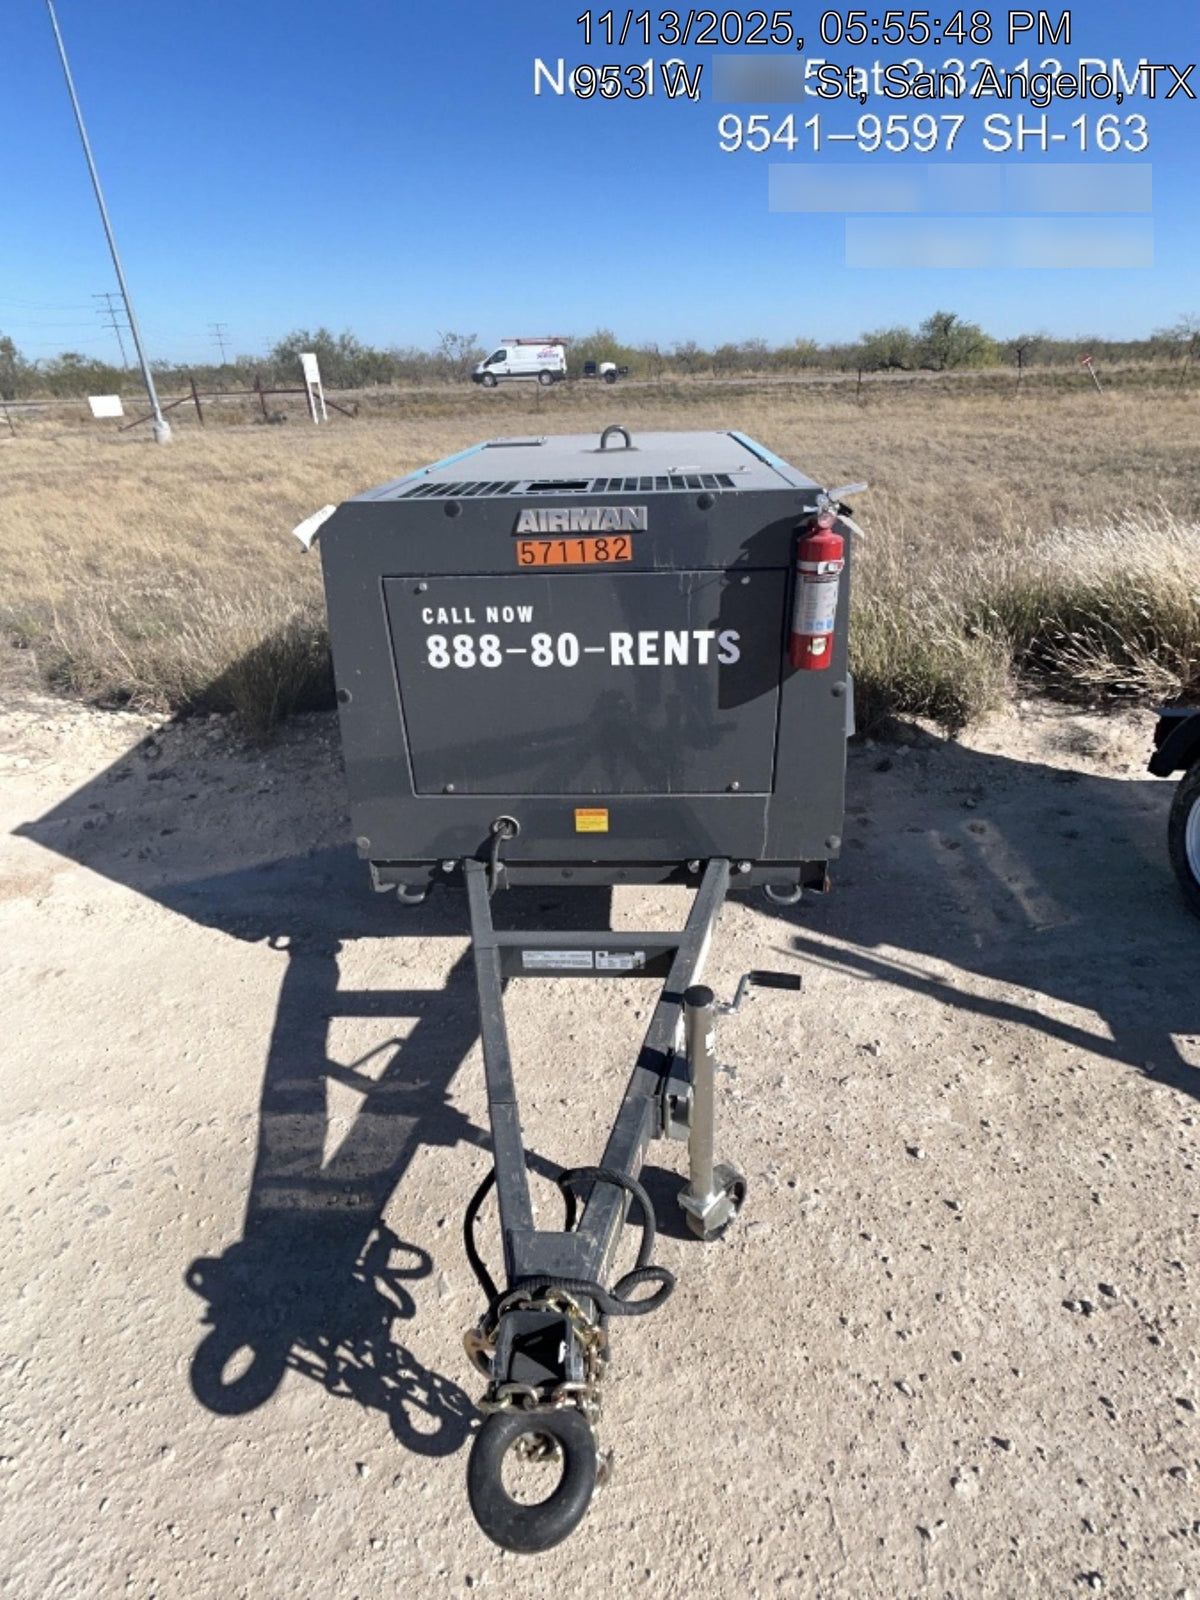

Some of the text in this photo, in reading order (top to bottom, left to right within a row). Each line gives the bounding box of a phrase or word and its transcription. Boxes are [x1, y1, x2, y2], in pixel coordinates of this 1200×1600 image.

[515, 506, 648, 534] AIRMAN
[521, 537, 629, 565] 571182
[422, 605, 534, 624] CALL NOW
